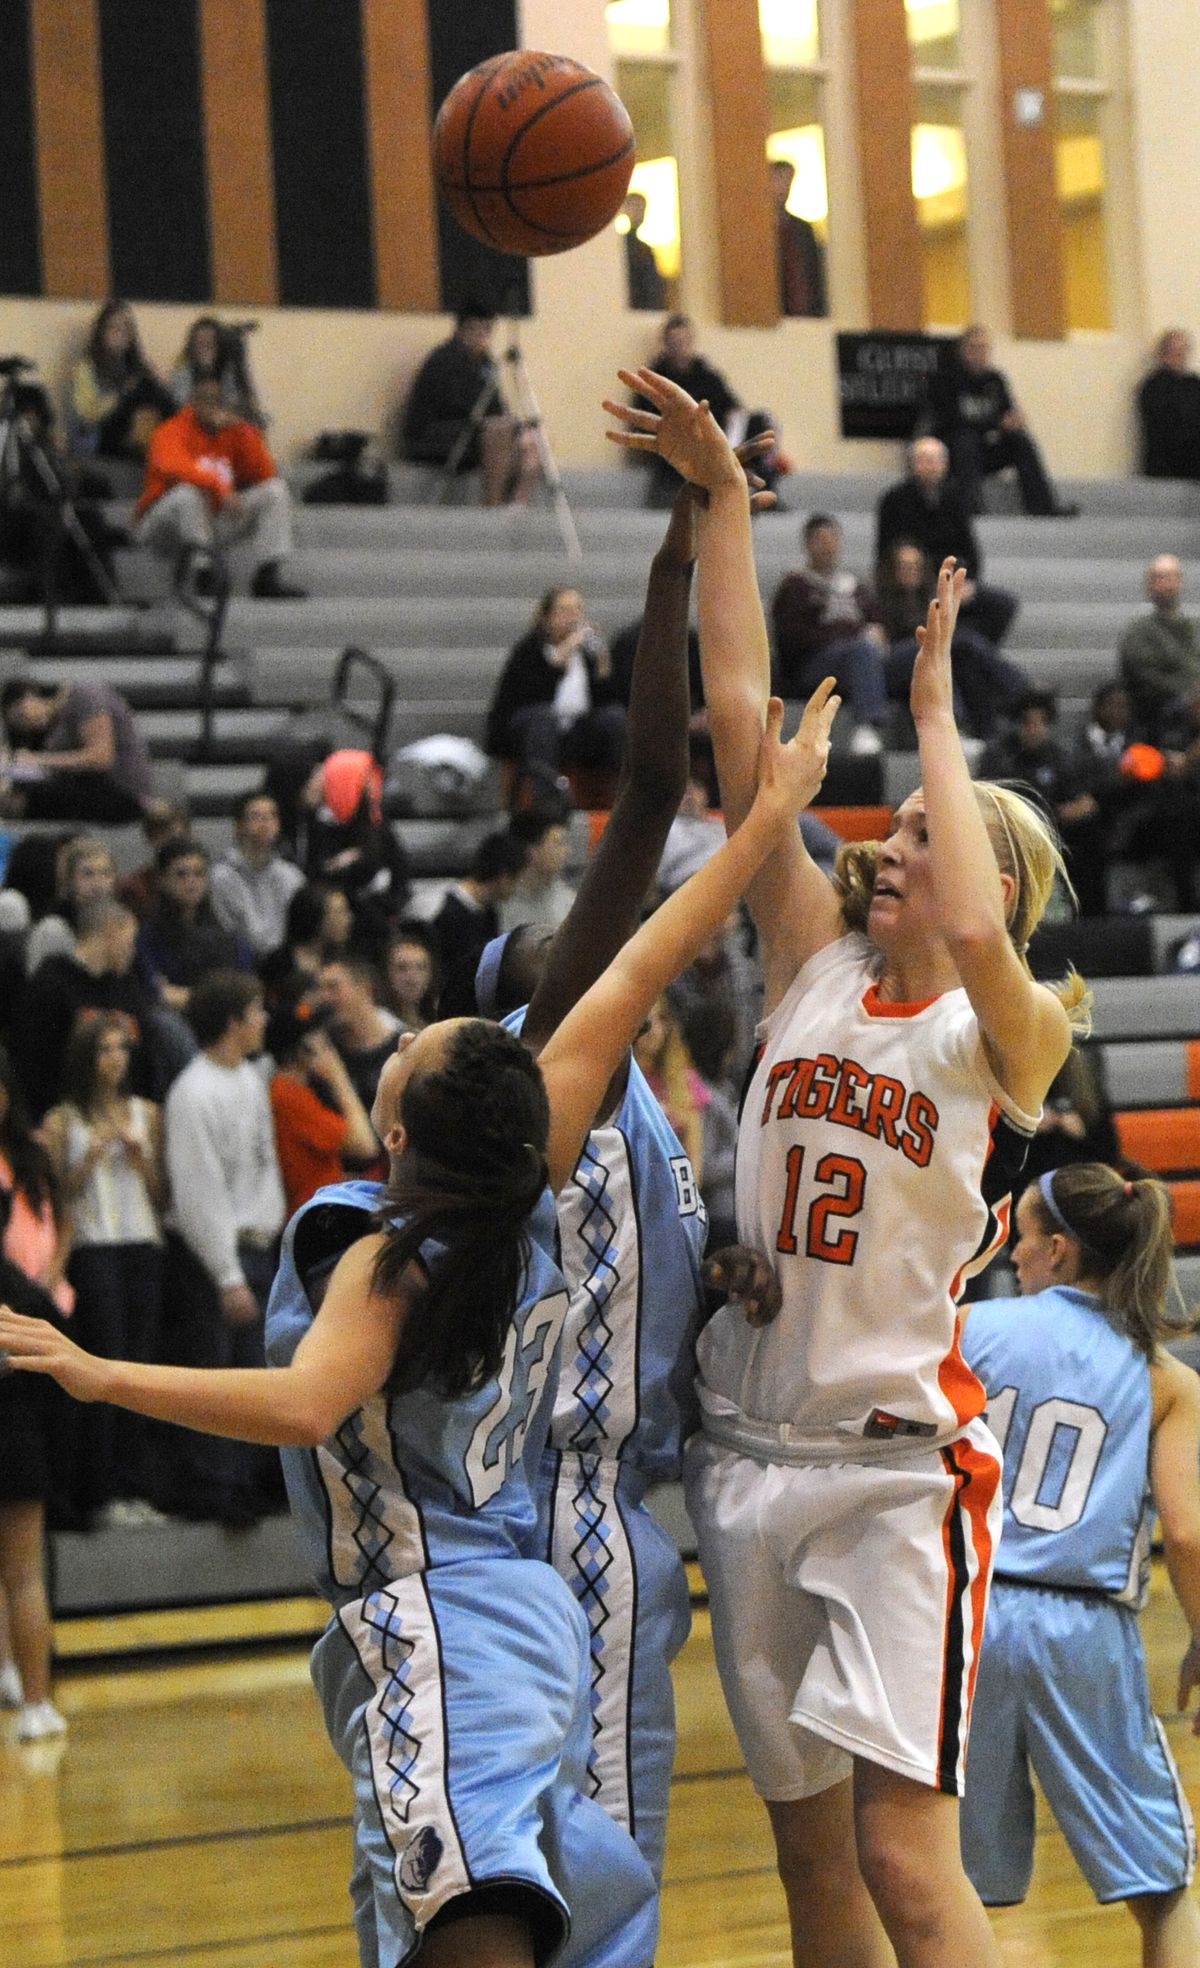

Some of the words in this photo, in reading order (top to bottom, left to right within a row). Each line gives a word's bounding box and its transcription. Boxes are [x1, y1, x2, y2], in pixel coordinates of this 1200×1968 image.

[762, 1053, 939, 1168] TIGERS
[776, 1144, 867, 1266] 12
[465, 1289, 570, 1511] 23
